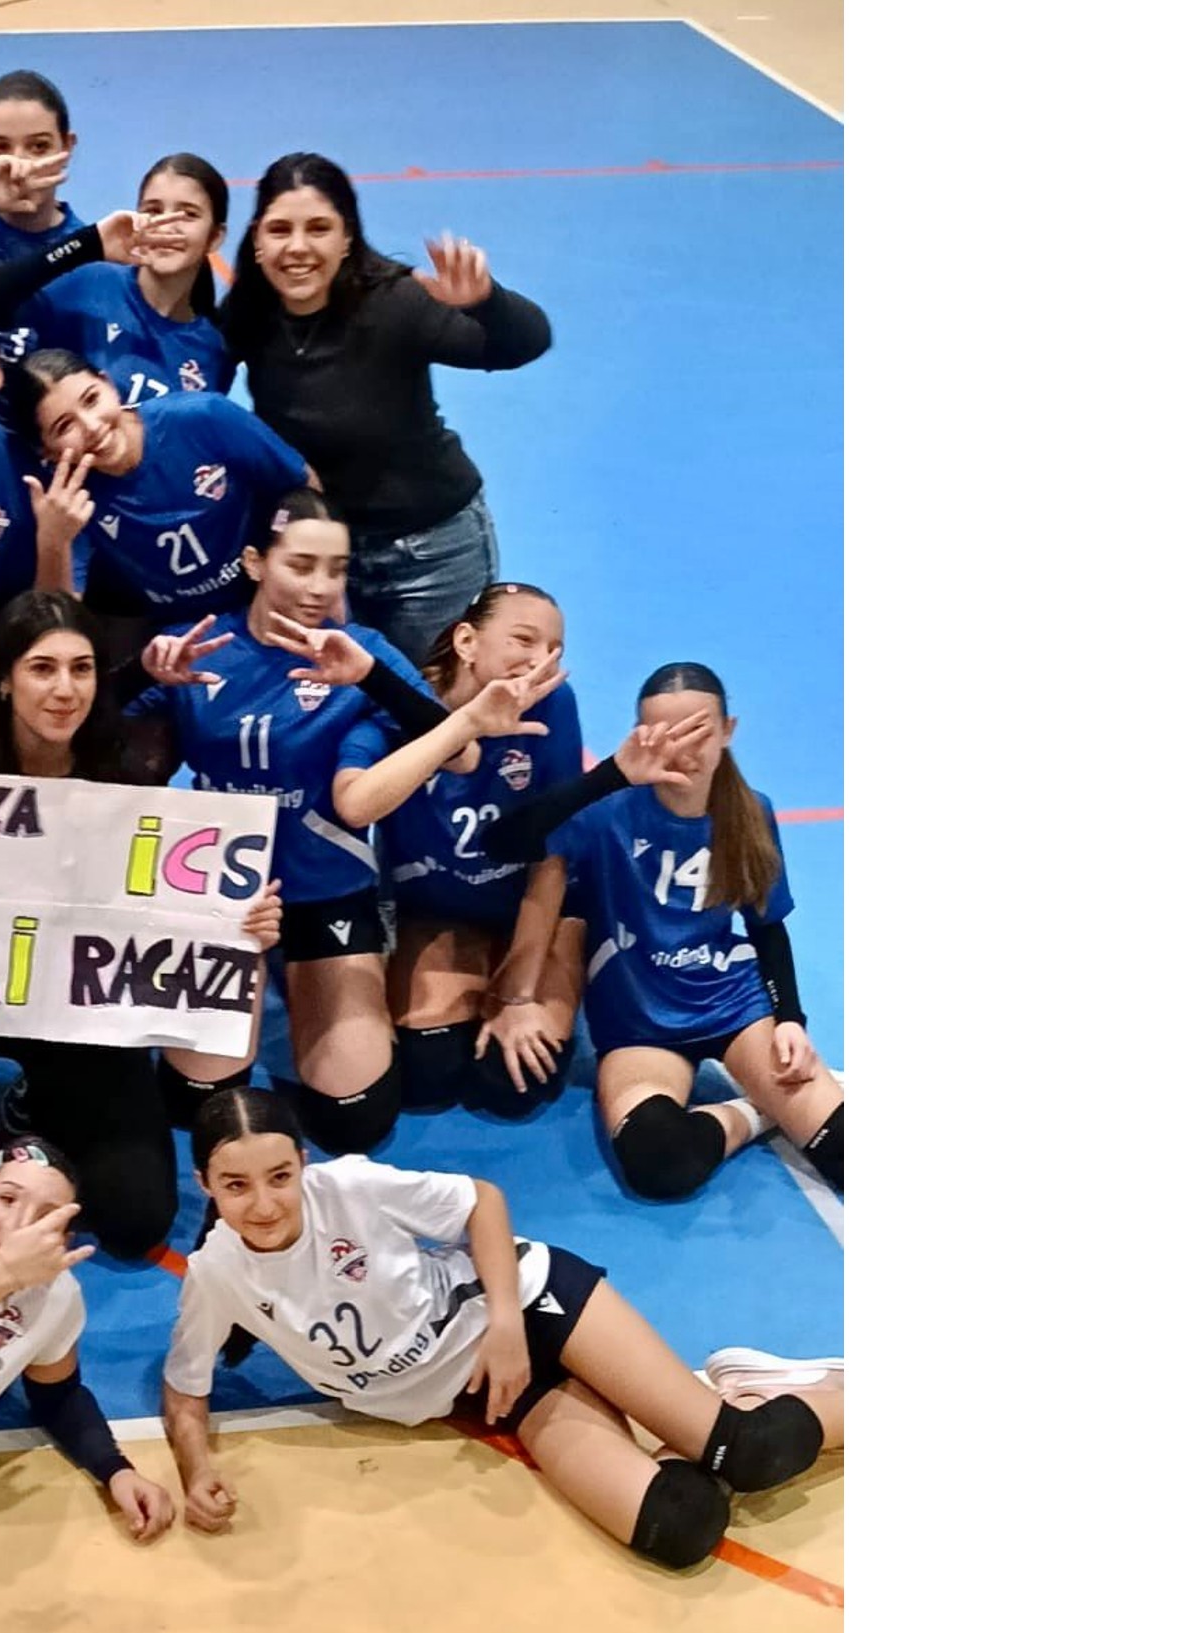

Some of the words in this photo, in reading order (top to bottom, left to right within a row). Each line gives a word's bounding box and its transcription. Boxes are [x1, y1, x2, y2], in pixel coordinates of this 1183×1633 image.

[156, 523, 210, 576] 21
[239, 714, 273, 770] 11
[654, 847, 712, 912] 14
[69, 934, 259, 1013] RAGAZZE
[309, 1302, 383, 1367] 32
